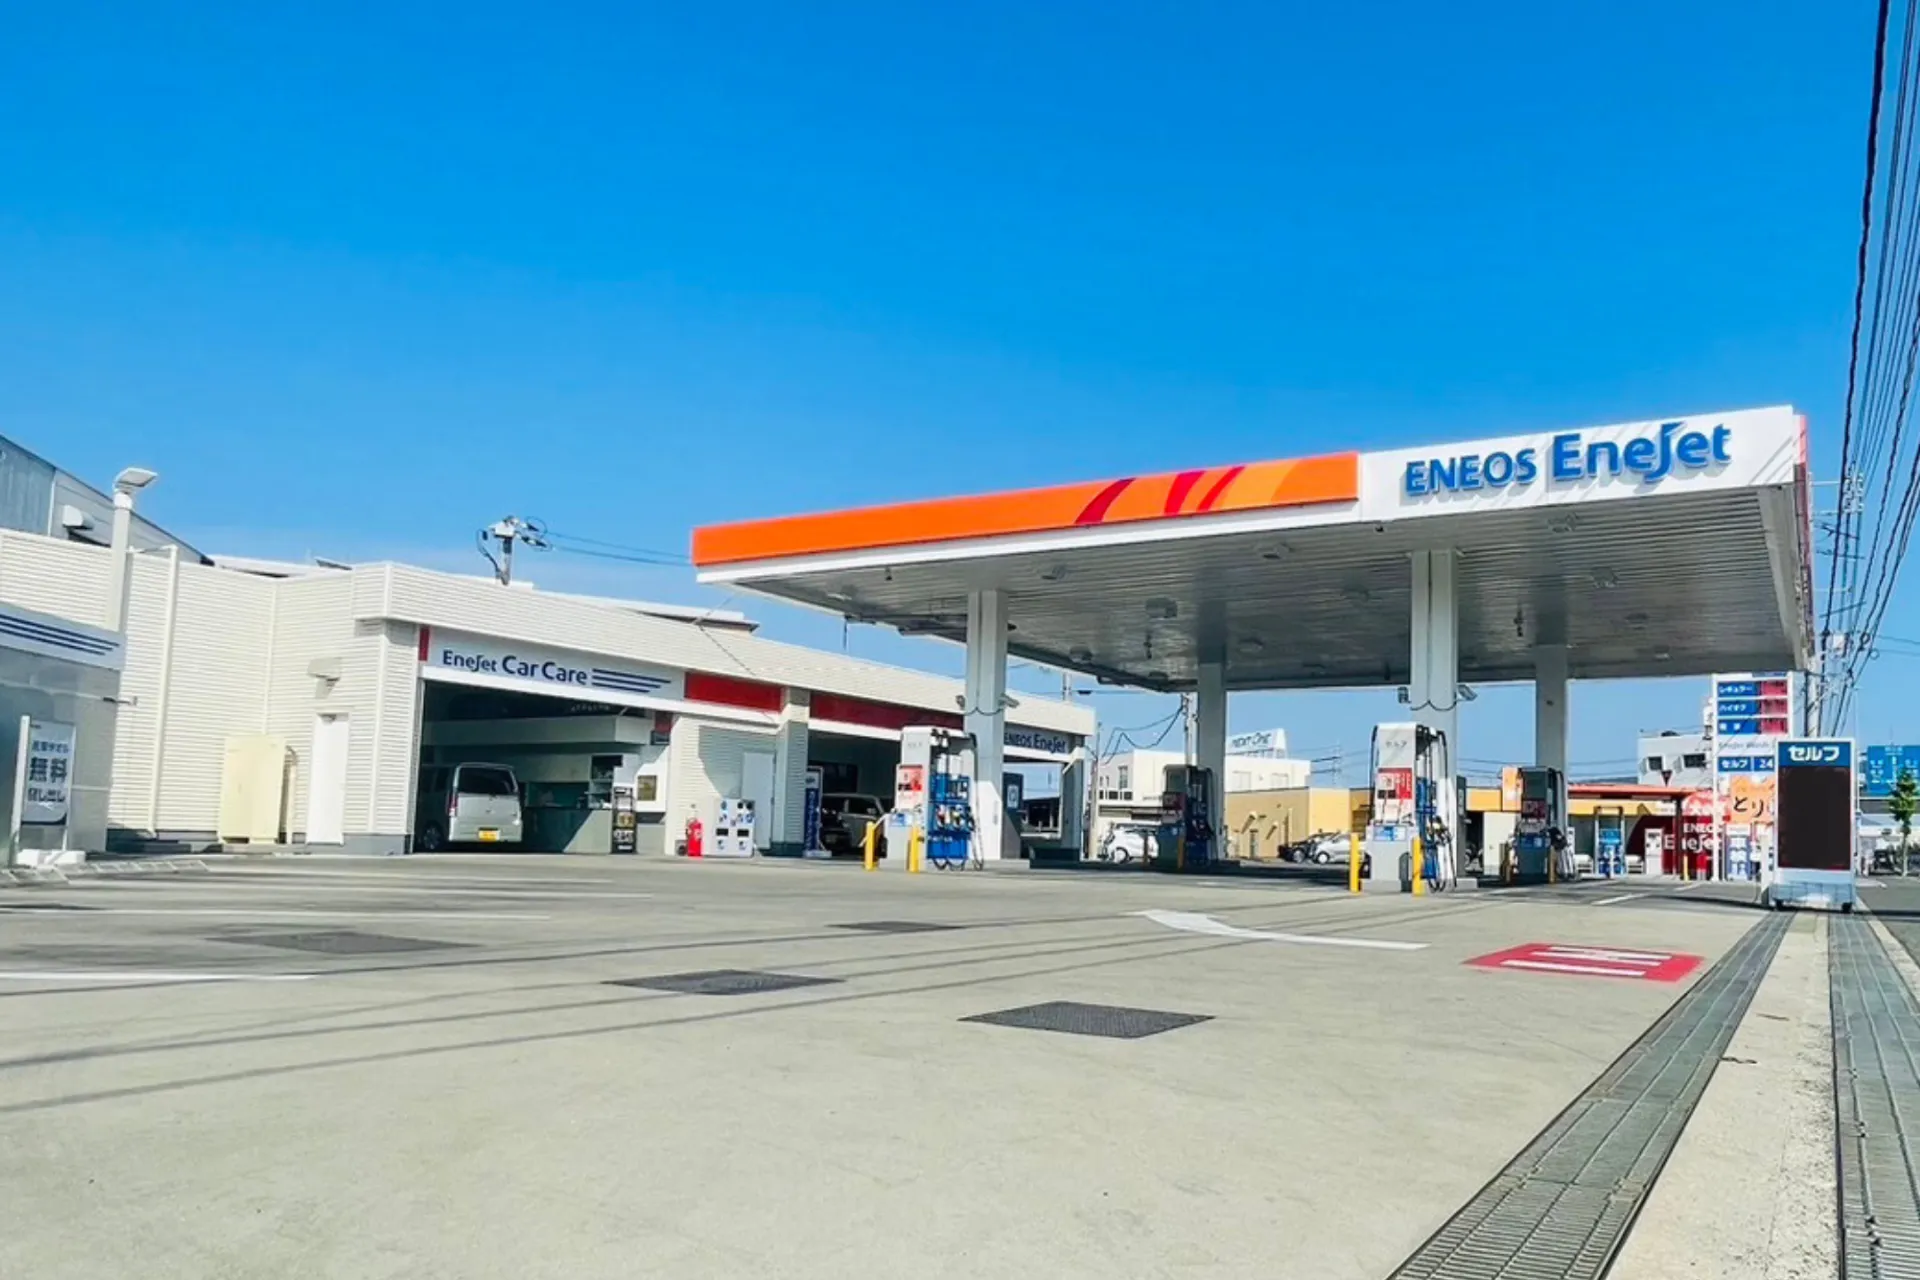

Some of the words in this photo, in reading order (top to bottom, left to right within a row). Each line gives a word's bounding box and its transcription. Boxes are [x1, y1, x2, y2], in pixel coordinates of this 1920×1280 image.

[1405, 448, 1538, 496] ENEOS
[1552, 421, 1732, 483] EneJet
[442, 650, 497, 672] EneJet
[502, 655, 539, 677] Car
[541, 661, 587, 685] Care
[1788, 744, 1840, 762] セルフ
